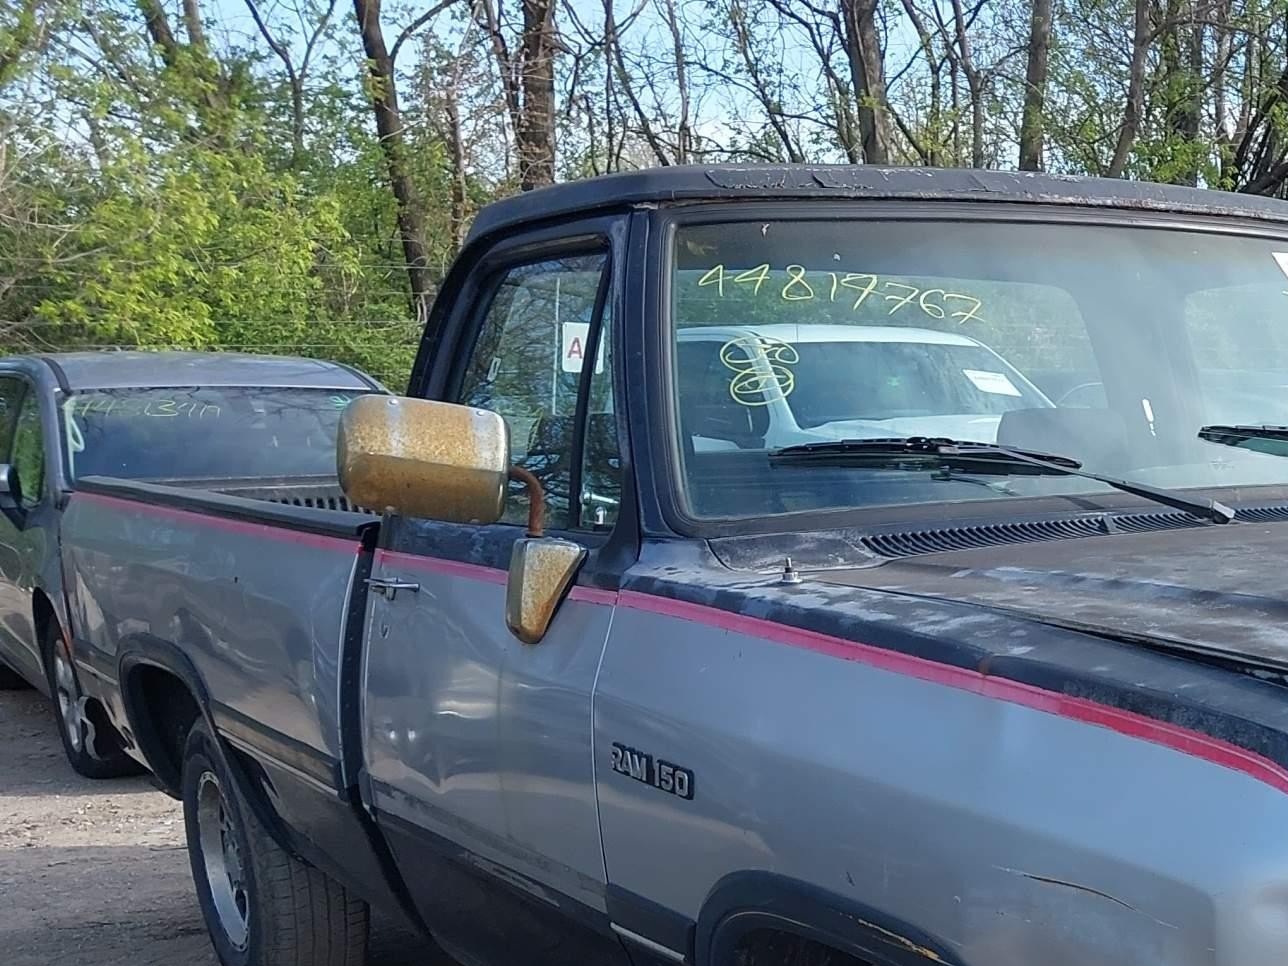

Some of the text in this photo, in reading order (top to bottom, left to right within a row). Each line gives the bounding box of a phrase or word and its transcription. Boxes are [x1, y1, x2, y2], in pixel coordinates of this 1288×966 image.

[567, 337, 583, 358] A
[611, 745, 690, 797] RAM 150
